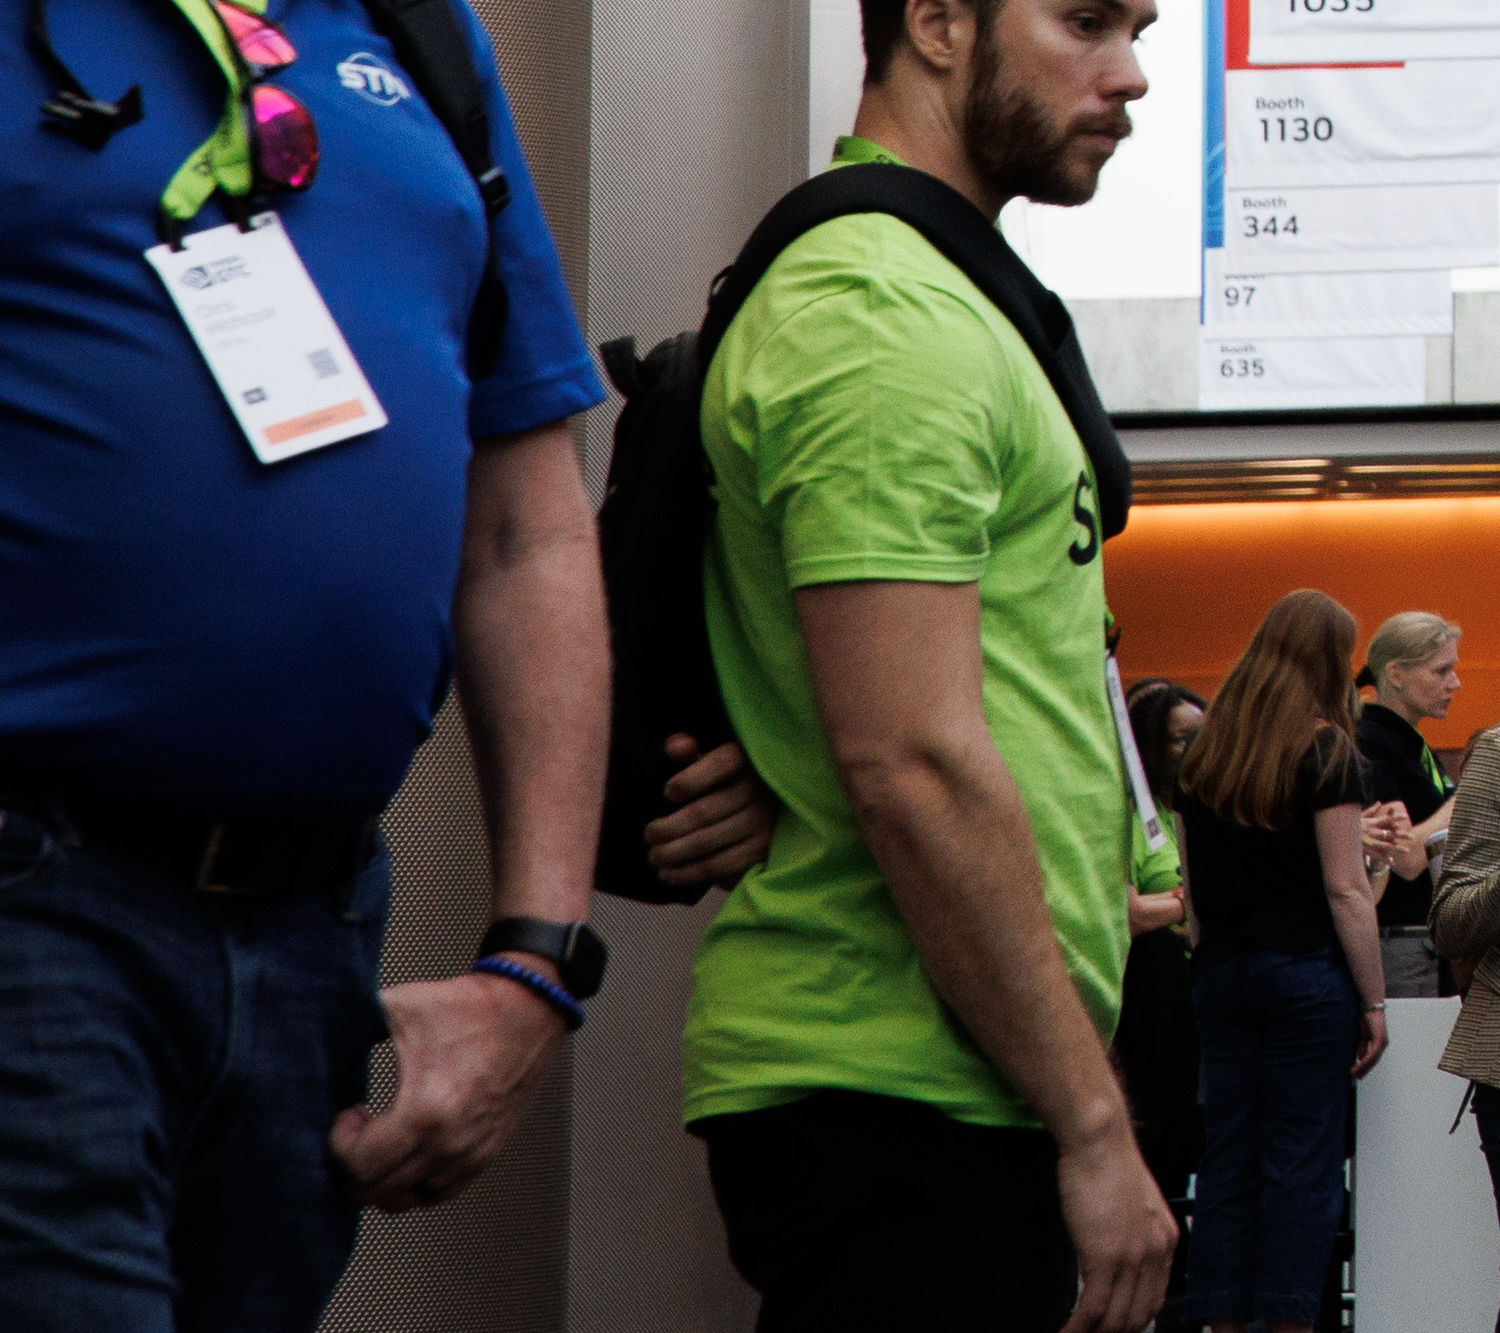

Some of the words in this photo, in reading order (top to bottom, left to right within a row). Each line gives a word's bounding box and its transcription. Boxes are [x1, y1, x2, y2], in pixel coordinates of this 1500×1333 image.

[1255, 96, 1305, 111] Booth
[1259, 116, 1334, 143] 1130
[1242, 196, 1287, 211] Booth
[1243, 214, 1300, 238] 344
[1224, 286, 1257, 307] 97
[1220, 359, 1265, 378] 635
